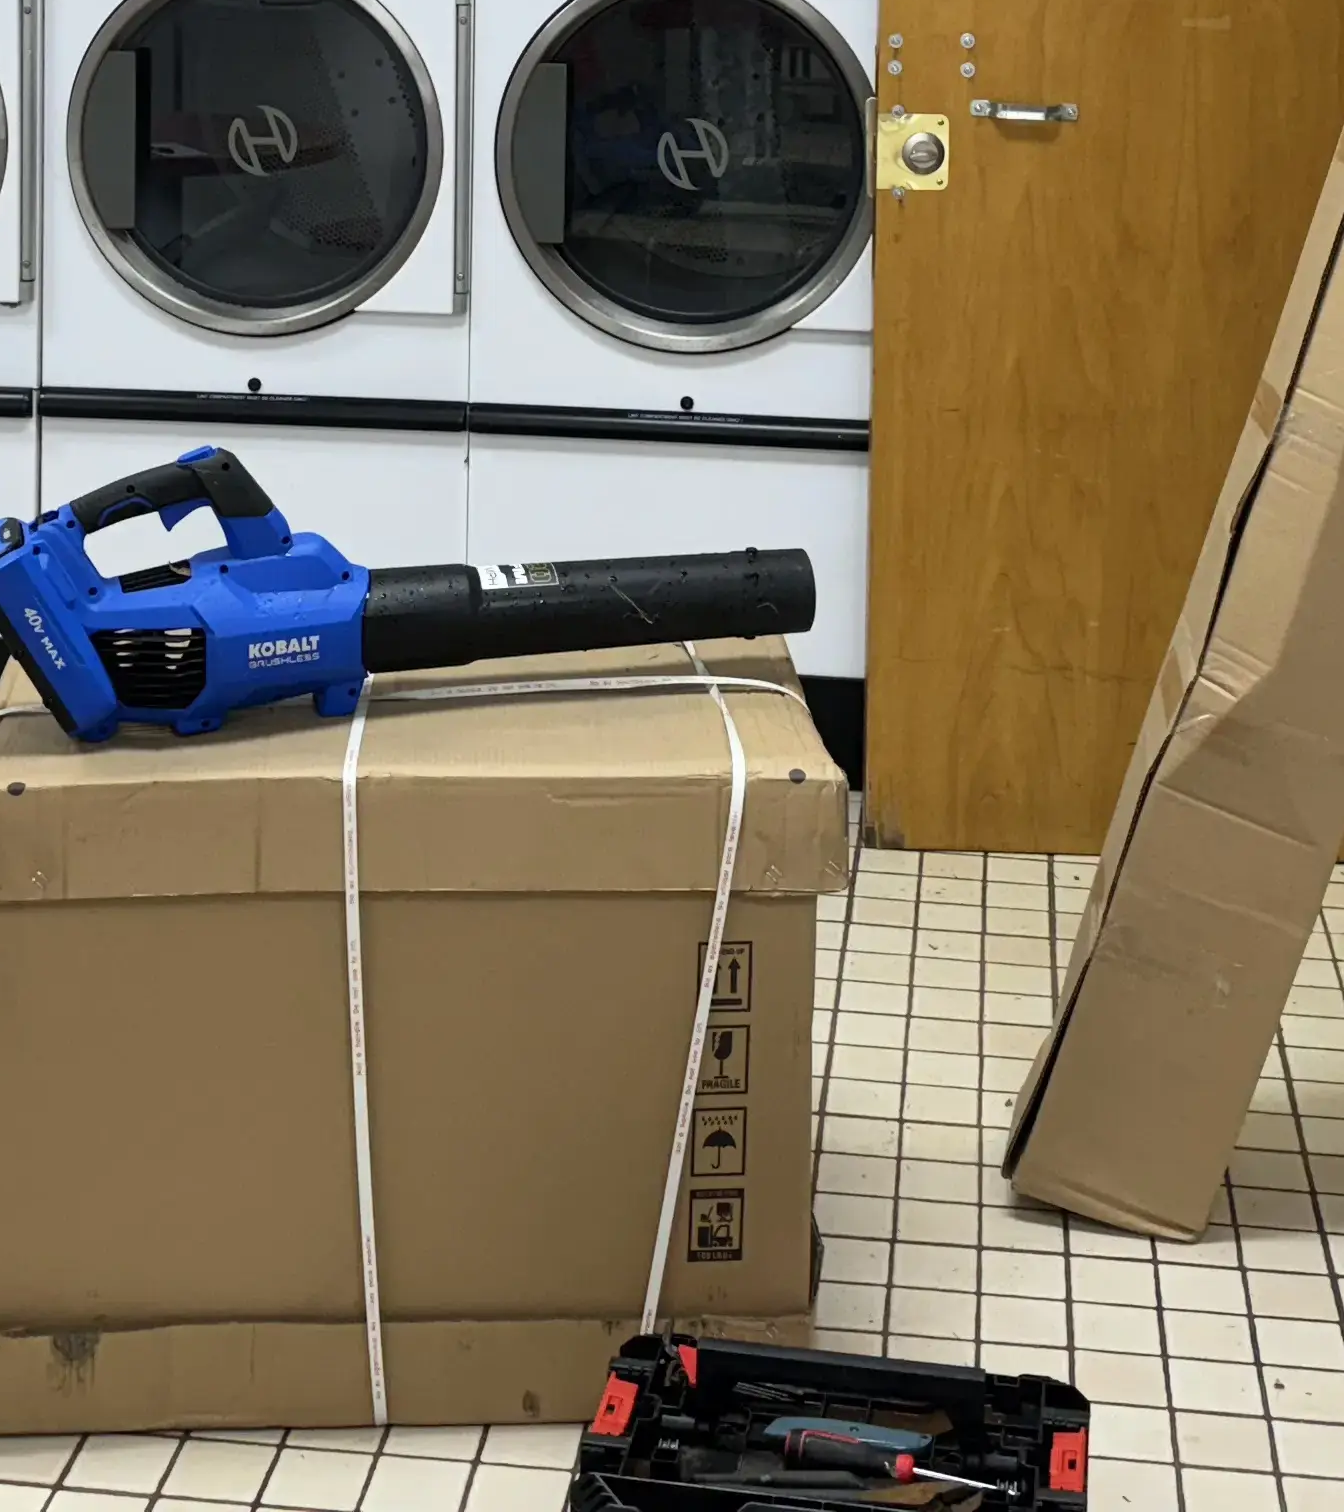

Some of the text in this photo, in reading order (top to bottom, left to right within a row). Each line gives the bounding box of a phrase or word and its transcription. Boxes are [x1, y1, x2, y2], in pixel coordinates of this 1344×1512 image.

[40, 635, 67, 671] MAX
[247, 634, 321, 660] KOBALT
[248, 651, 321, 670] BRUSHLESS
[701, 1078, 741, 1090] FRAGILE
